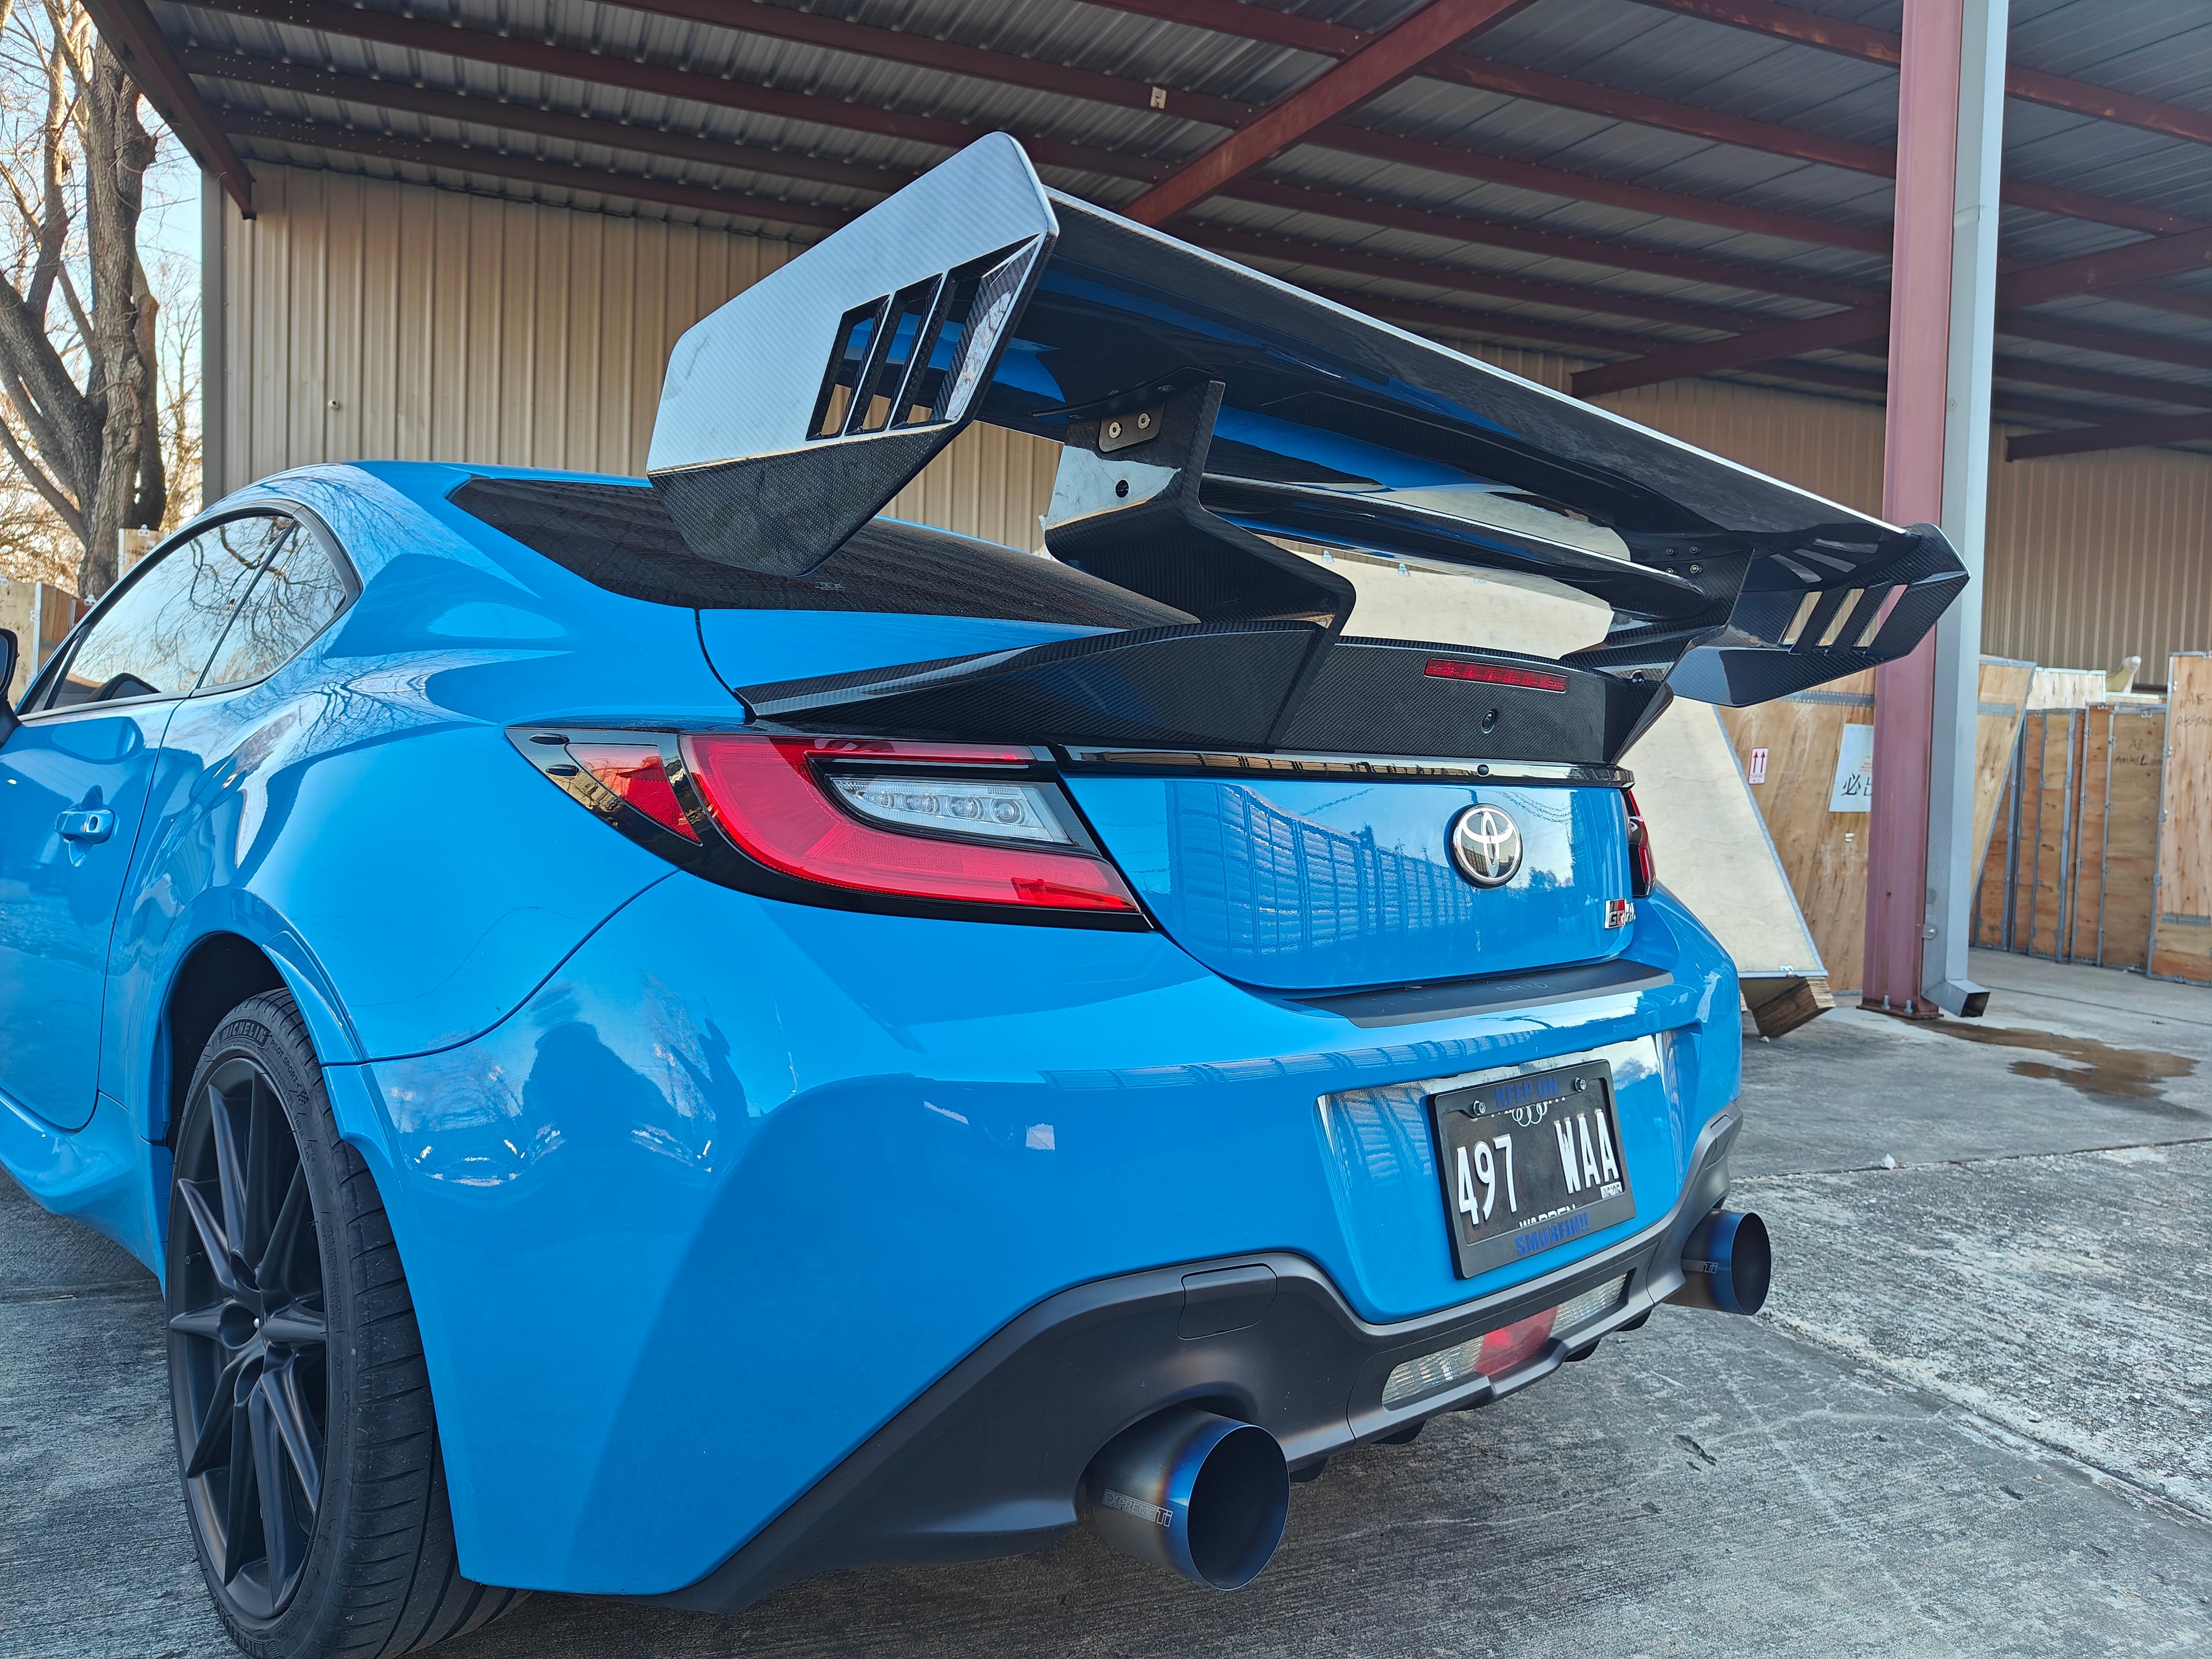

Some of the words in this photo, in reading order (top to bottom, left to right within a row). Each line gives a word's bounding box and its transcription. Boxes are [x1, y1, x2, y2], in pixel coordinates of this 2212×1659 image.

[221, 1022, 267, 1043] MICHELIN
[270, 1038, 284, 1058] PILOT
[282, 1057, 298, 1083] SPORT
[1494, 1081, 1533, 1109] KEEP
[1537, 1075, 1560, 1098] ON
[1456, 1133, 1517, 1225] 497
[1554, 1109, 1620, 1195] WAA
[1515, 1211, 1590, 1258] SMURFIN!!
[1102, 1488, 1157, 1522] EXPREME
[1156, 1507, 1174, 1528] Ti
